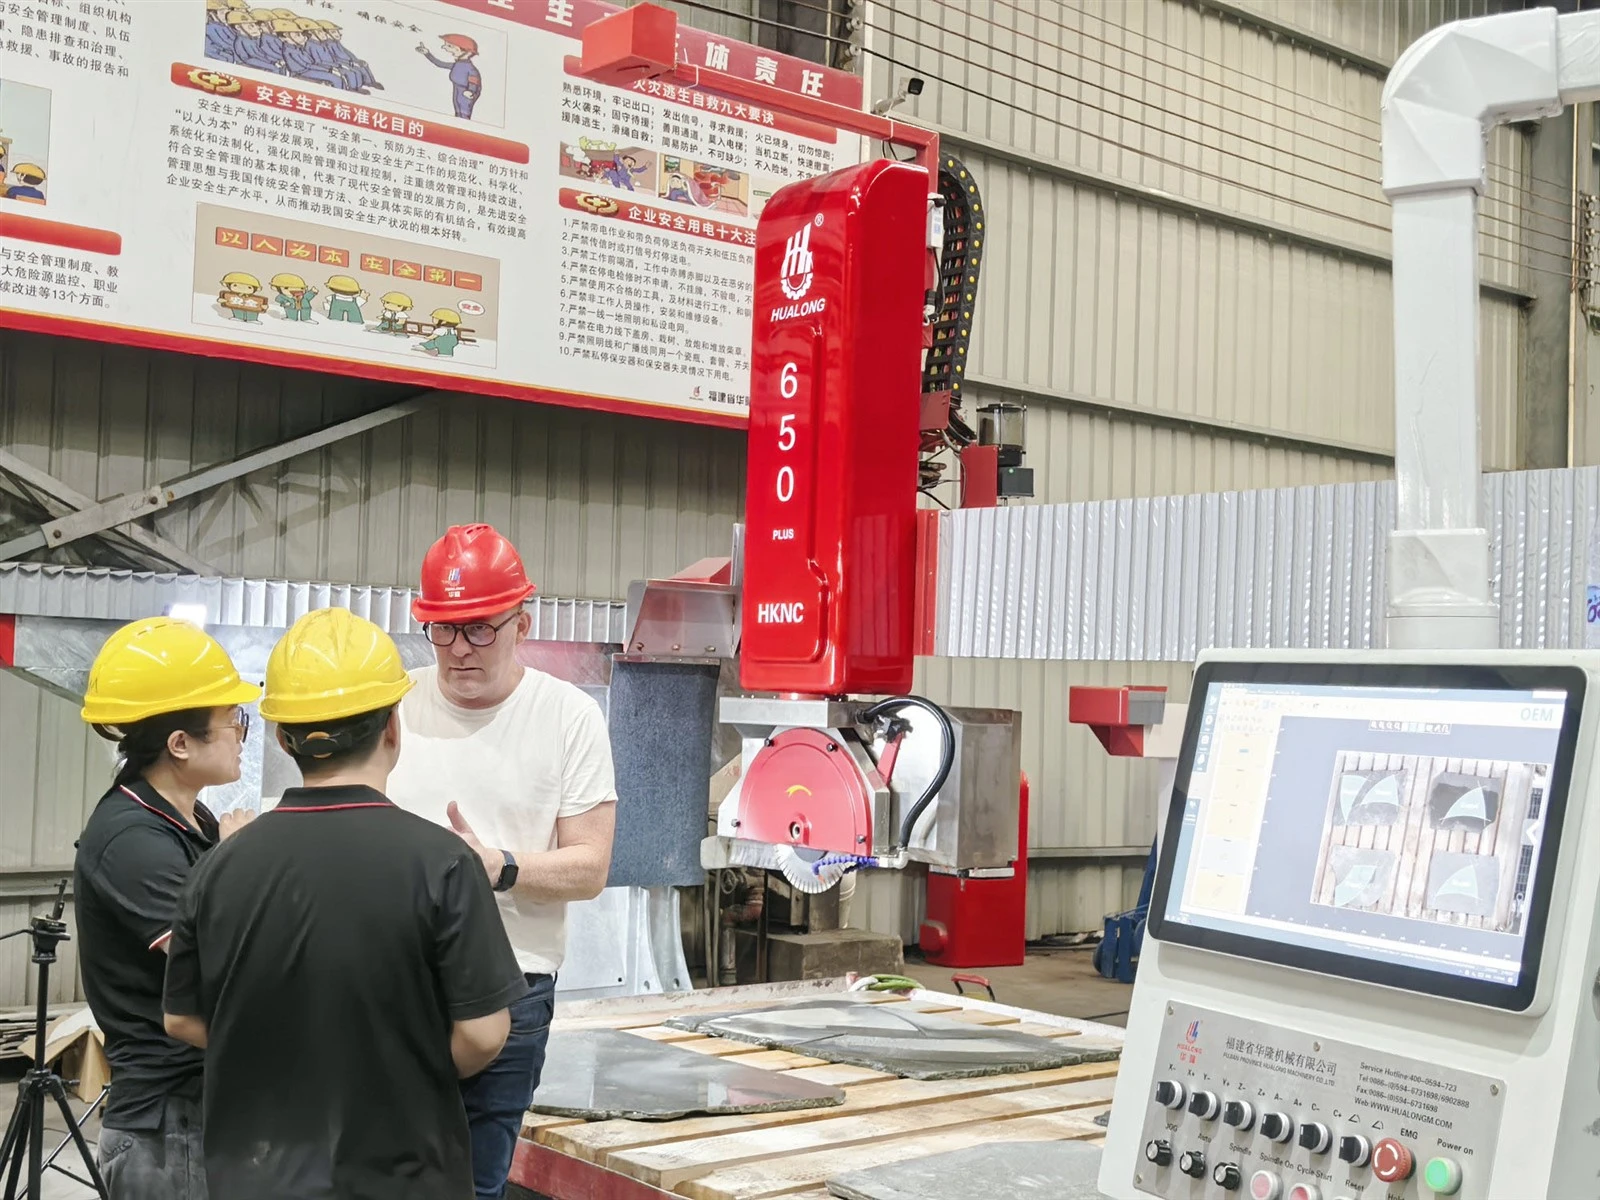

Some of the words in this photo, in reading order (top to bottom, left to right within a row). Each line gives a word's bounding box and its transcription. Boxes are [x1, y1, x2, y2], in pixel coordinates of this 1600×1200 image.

[0, 38, 129, 78] 救援、事故的报告和
[256, 85, 425, 138] 安全生产标准化目的
[221, 229, 343, 264] 以人为本
[770, 298, 826, 322] HUALONG
[772, 528, 795, 541] PLUS
[757, 602, 804, 624] HKNC
[1520, 707, 1554, 722] OEM
[1225, 1035, 1338, 1077] 福建省华隆机械有限公司
[1360, 1062, 1384, 1073] Service
[1400, 1127, 1419, 1141] EMG
[1229, 1142, 1252, 1156] Spindle
[1437, 1138, 1462, 1152] Power
[1463, 1147, 1474, 1156] on
[1259, 1152, 1284, 1166] Spindle
[1284, 1160, 1294, 1170] On
[1344, 1179, 1365, 1193] Reset
